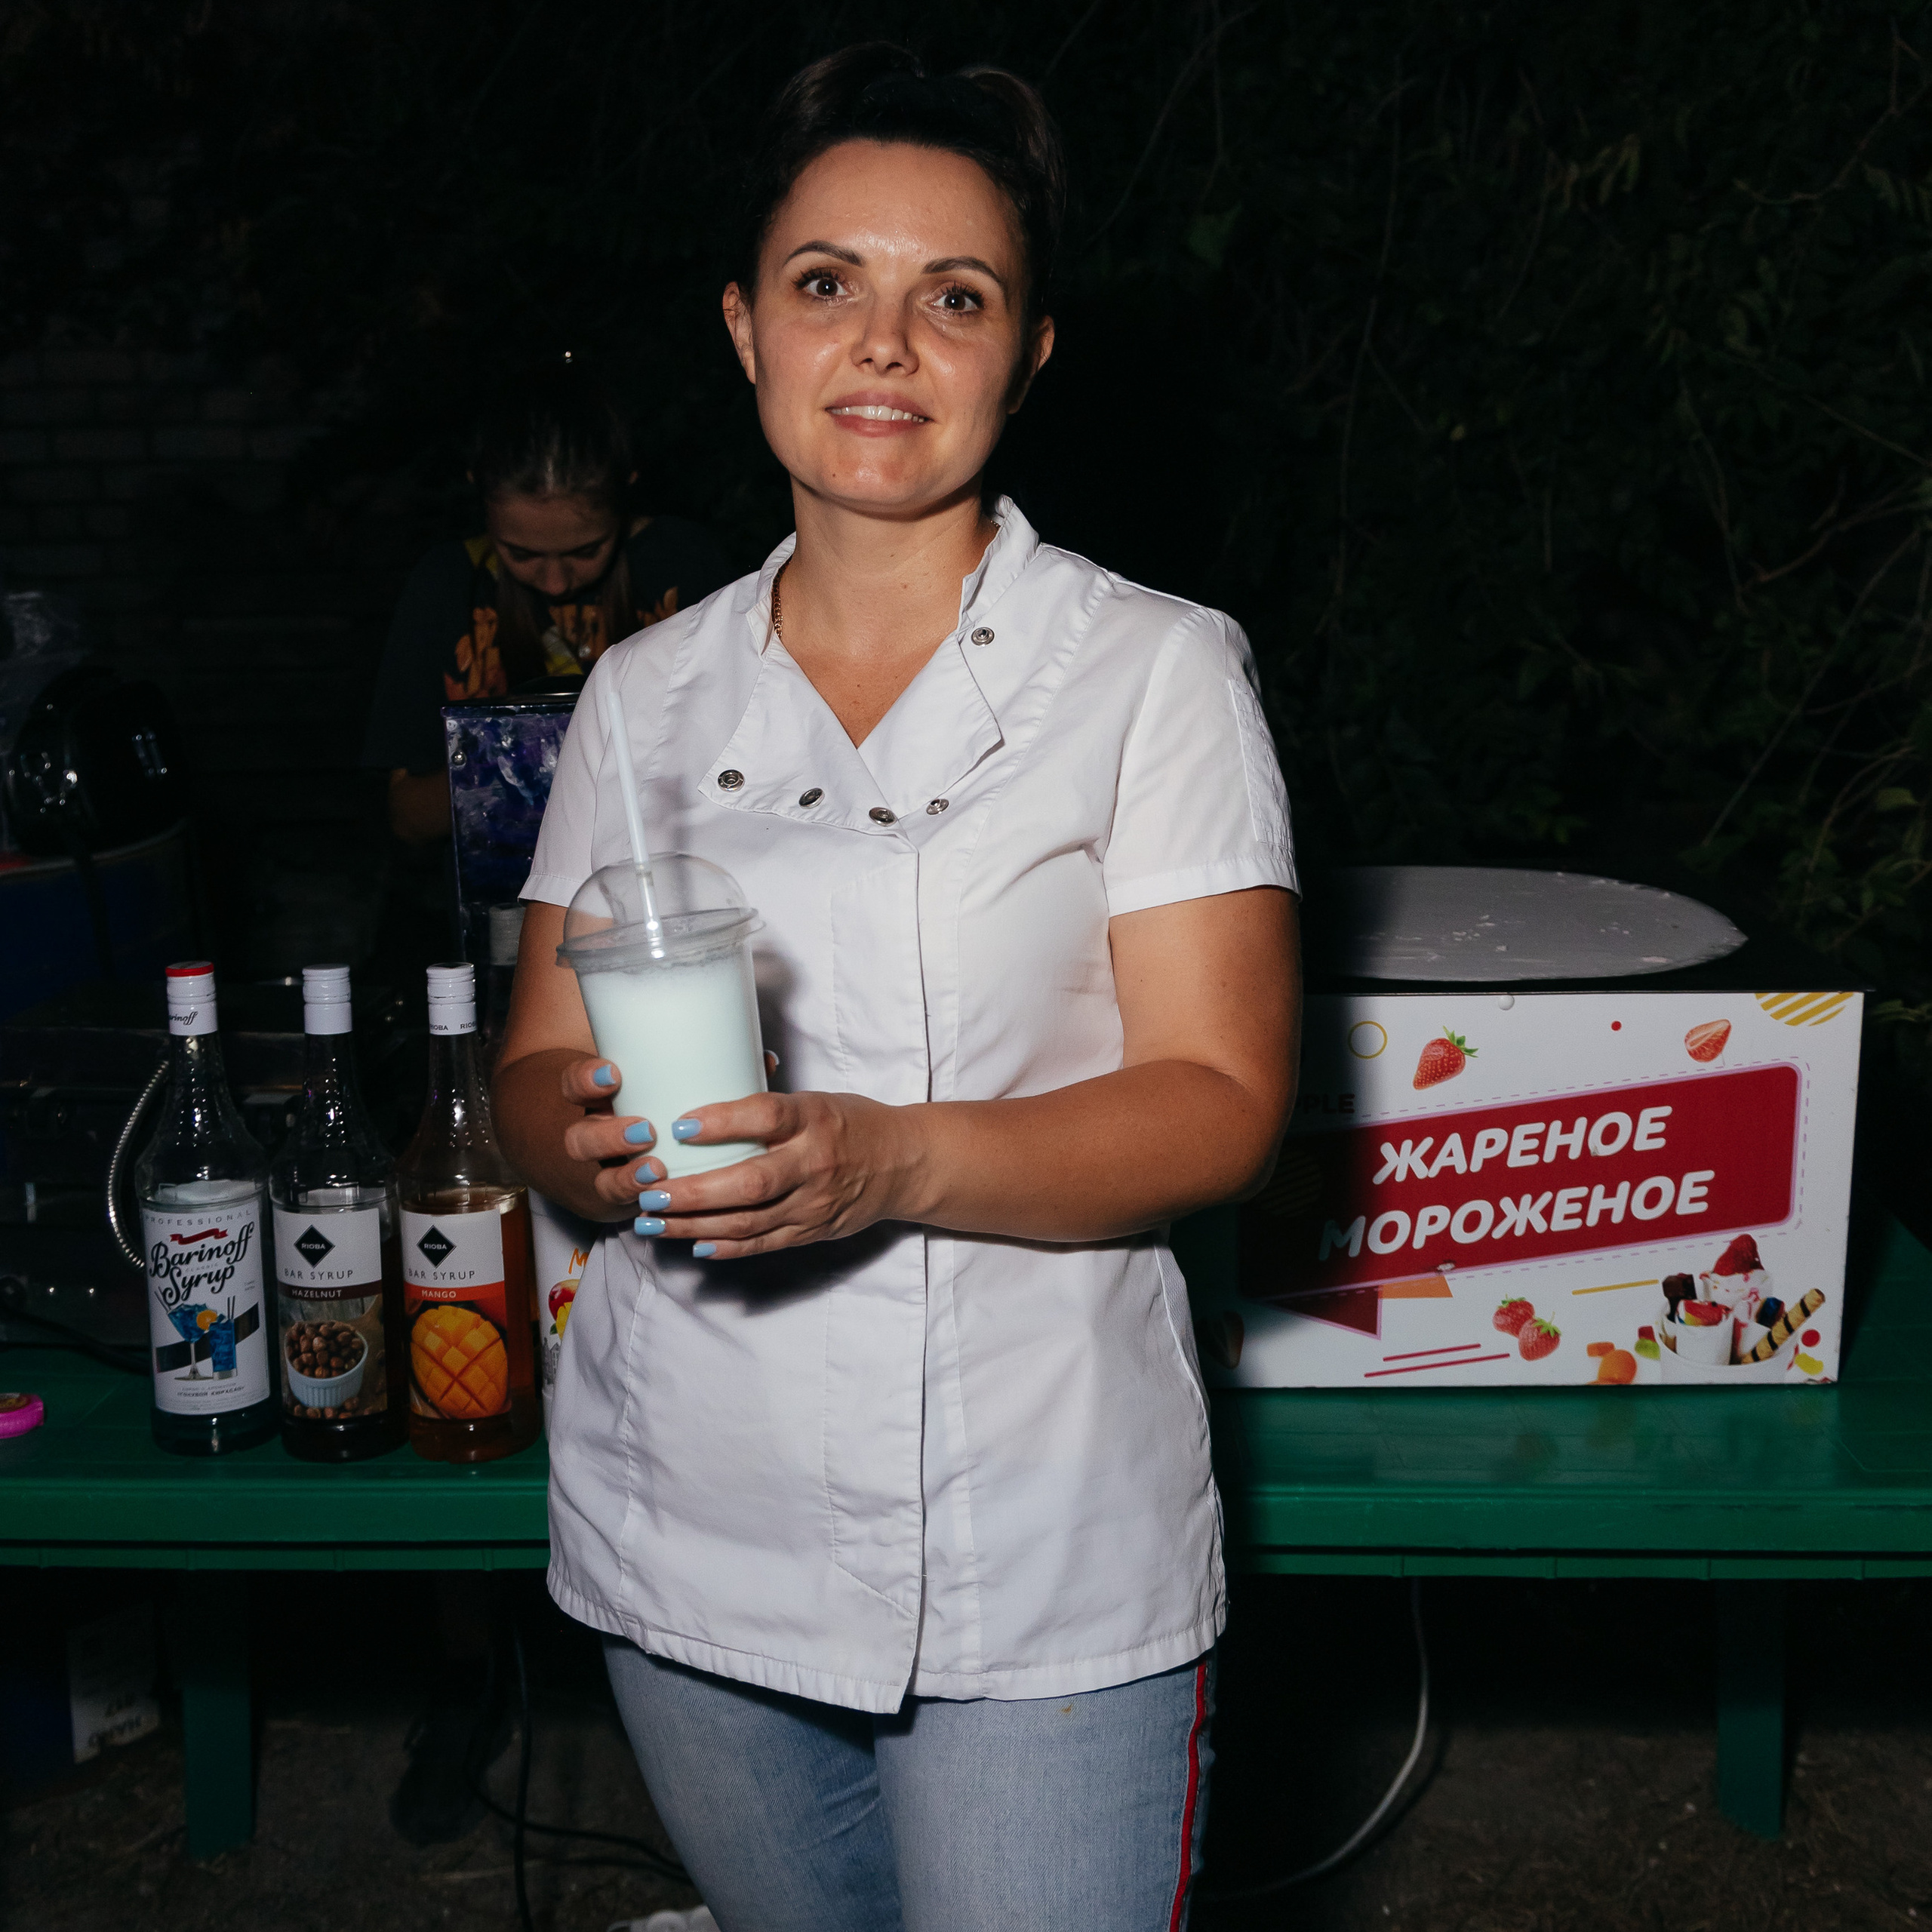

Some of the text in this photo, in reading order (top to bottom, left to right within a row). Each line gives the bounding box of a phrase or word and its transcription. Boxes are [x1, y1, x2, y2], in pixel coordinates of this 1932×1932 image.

[1297, 1094, 1355, 1115] PLE
[1372, 1106, 1672, 1185] ЖАРЕНОЕ
[146, 1210, 251, 1226] PROFESSIONAL
[1318, 1170, 1715, 1262] МОРОЖЕНОЕ
[149, 1221, 255, 1278] Barinoff
[284, 1268, 353, 1281] BAR SYRUP
[408, 1268, 475, 1281] BAR SYRUP
[162, 1264, 235, 1306] Syrup
[291, 1289, 342, 1299] HAZELNUT
[421, 1290, 457, 1299] MANGO
